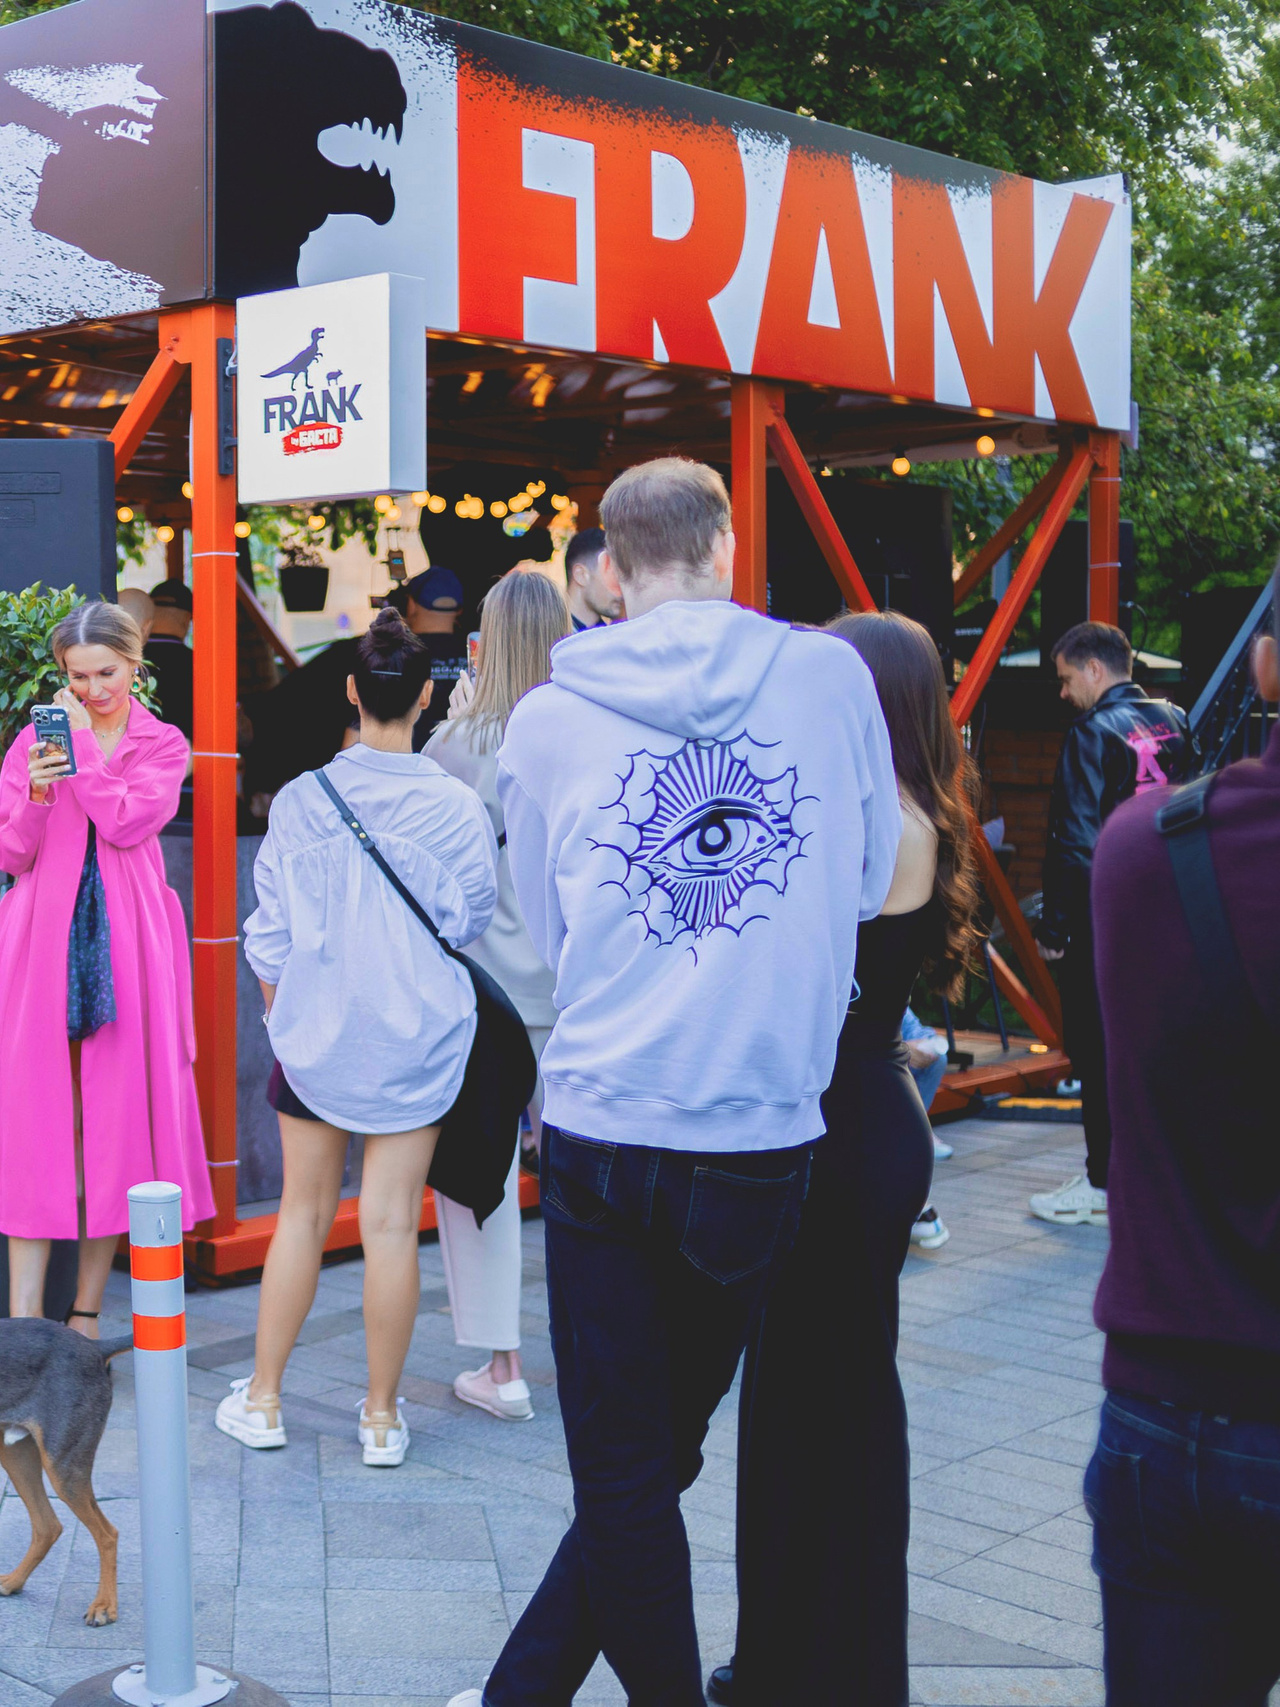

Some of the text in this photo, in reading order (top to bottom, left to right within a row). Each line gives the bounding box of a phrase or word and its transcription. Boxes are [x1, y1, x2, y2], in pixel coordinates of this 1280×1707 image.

[457, 43, 1115, 426] FRANK
[263, 383, 363, 434] FRANK
[299, 427, 339, 447] БАСТА
